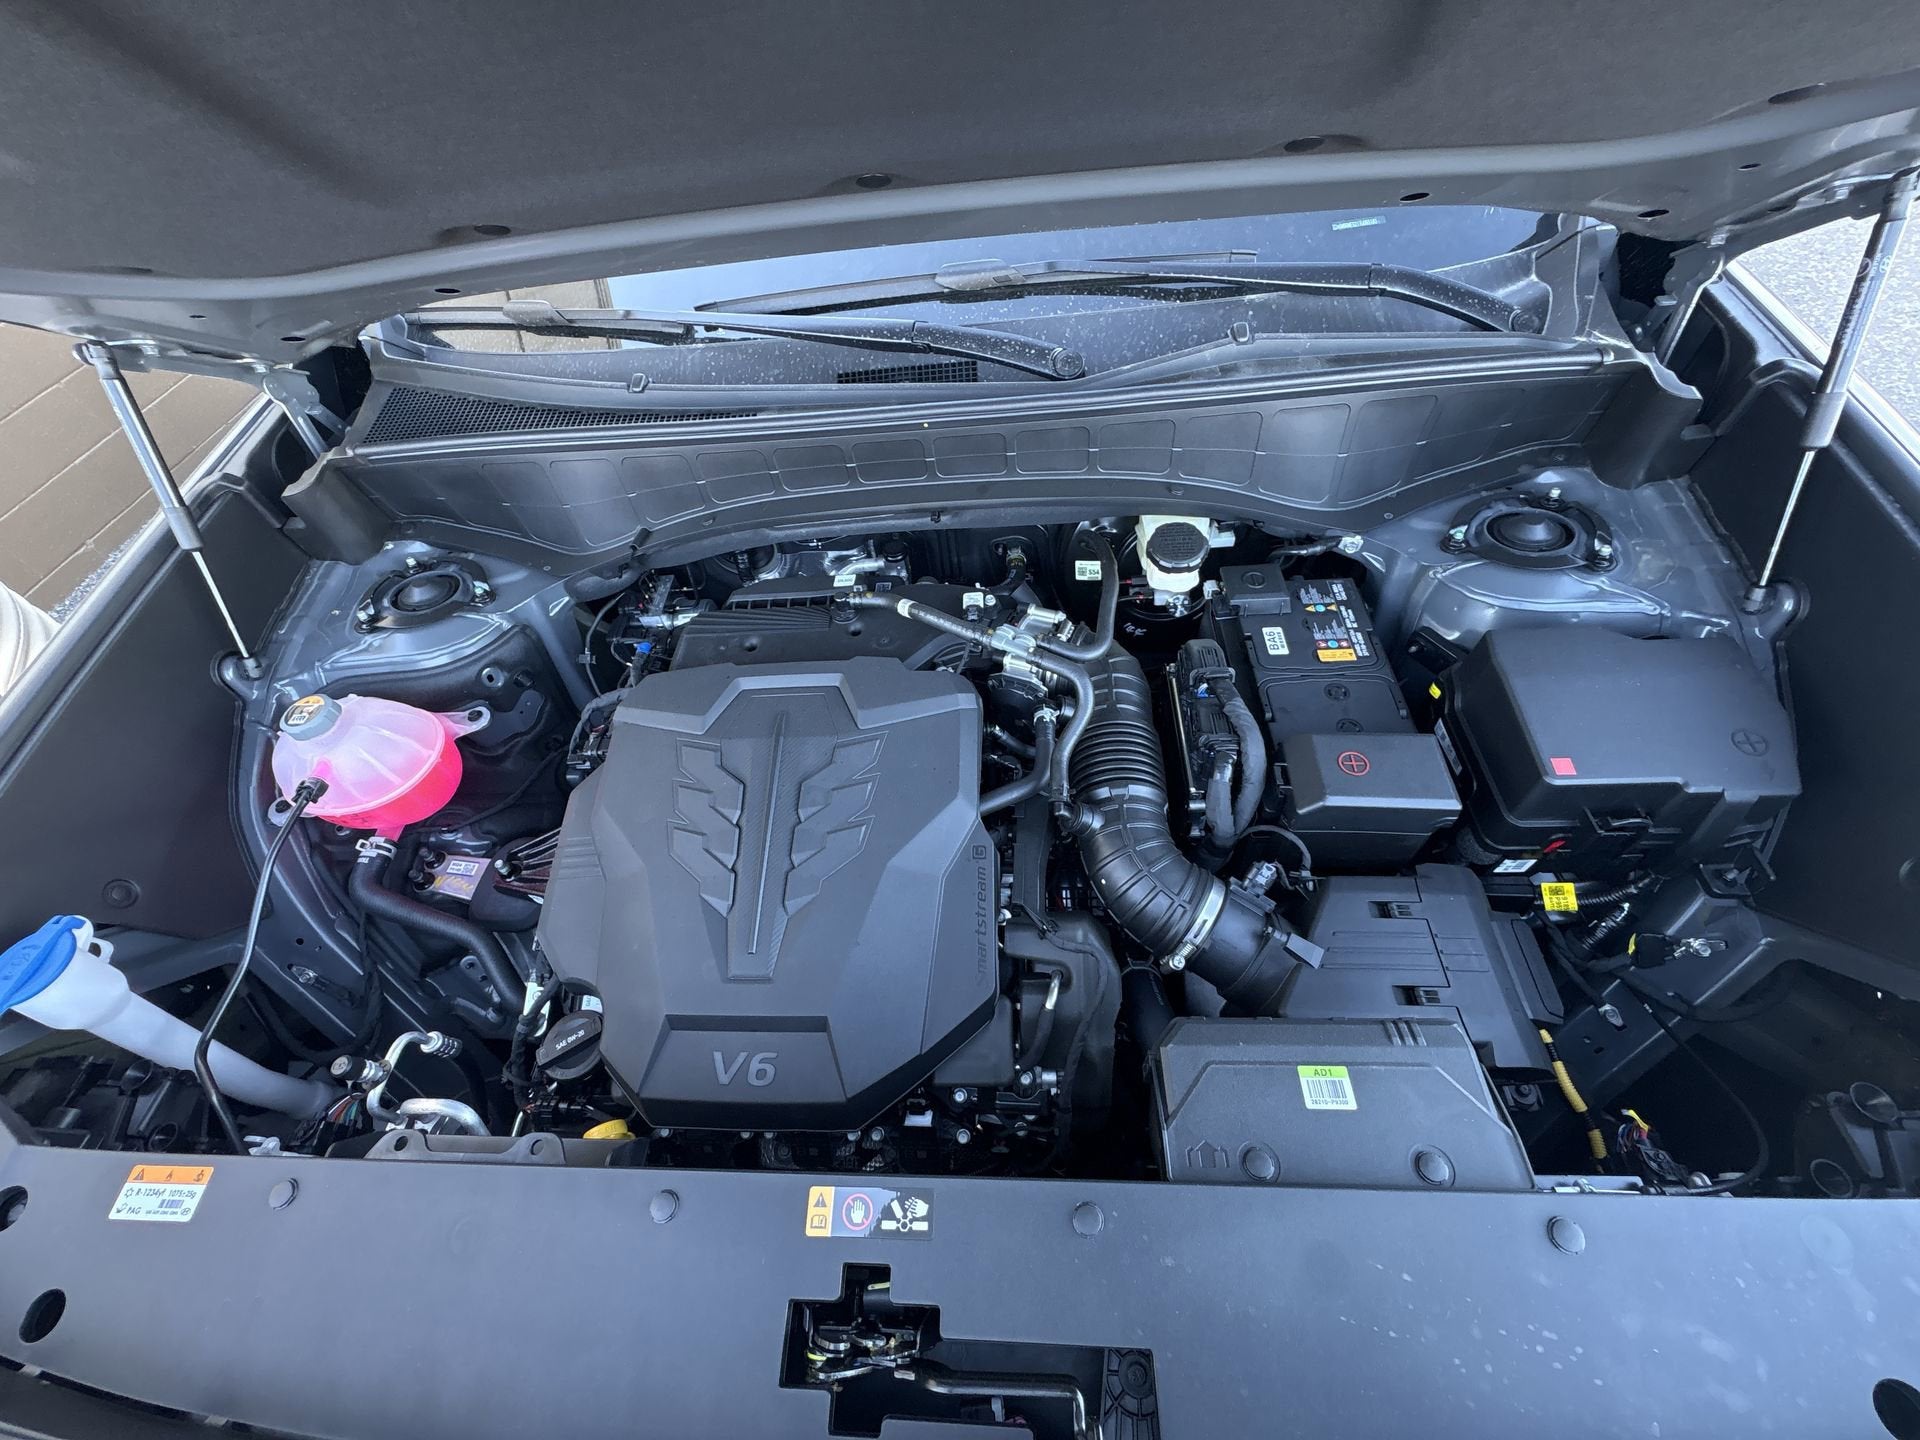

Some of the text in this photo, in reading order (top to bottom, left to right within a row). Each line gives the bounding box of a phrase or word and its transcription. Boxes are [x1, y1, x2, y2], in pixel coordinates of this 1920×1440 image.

[555, 1029, 585, 1050] SAE 0W-20
[713, 1051, 778, 1087] V6
[1314, 1068, 1333, 1077] AD1
[126, 1206, 142, 1215] PAG
